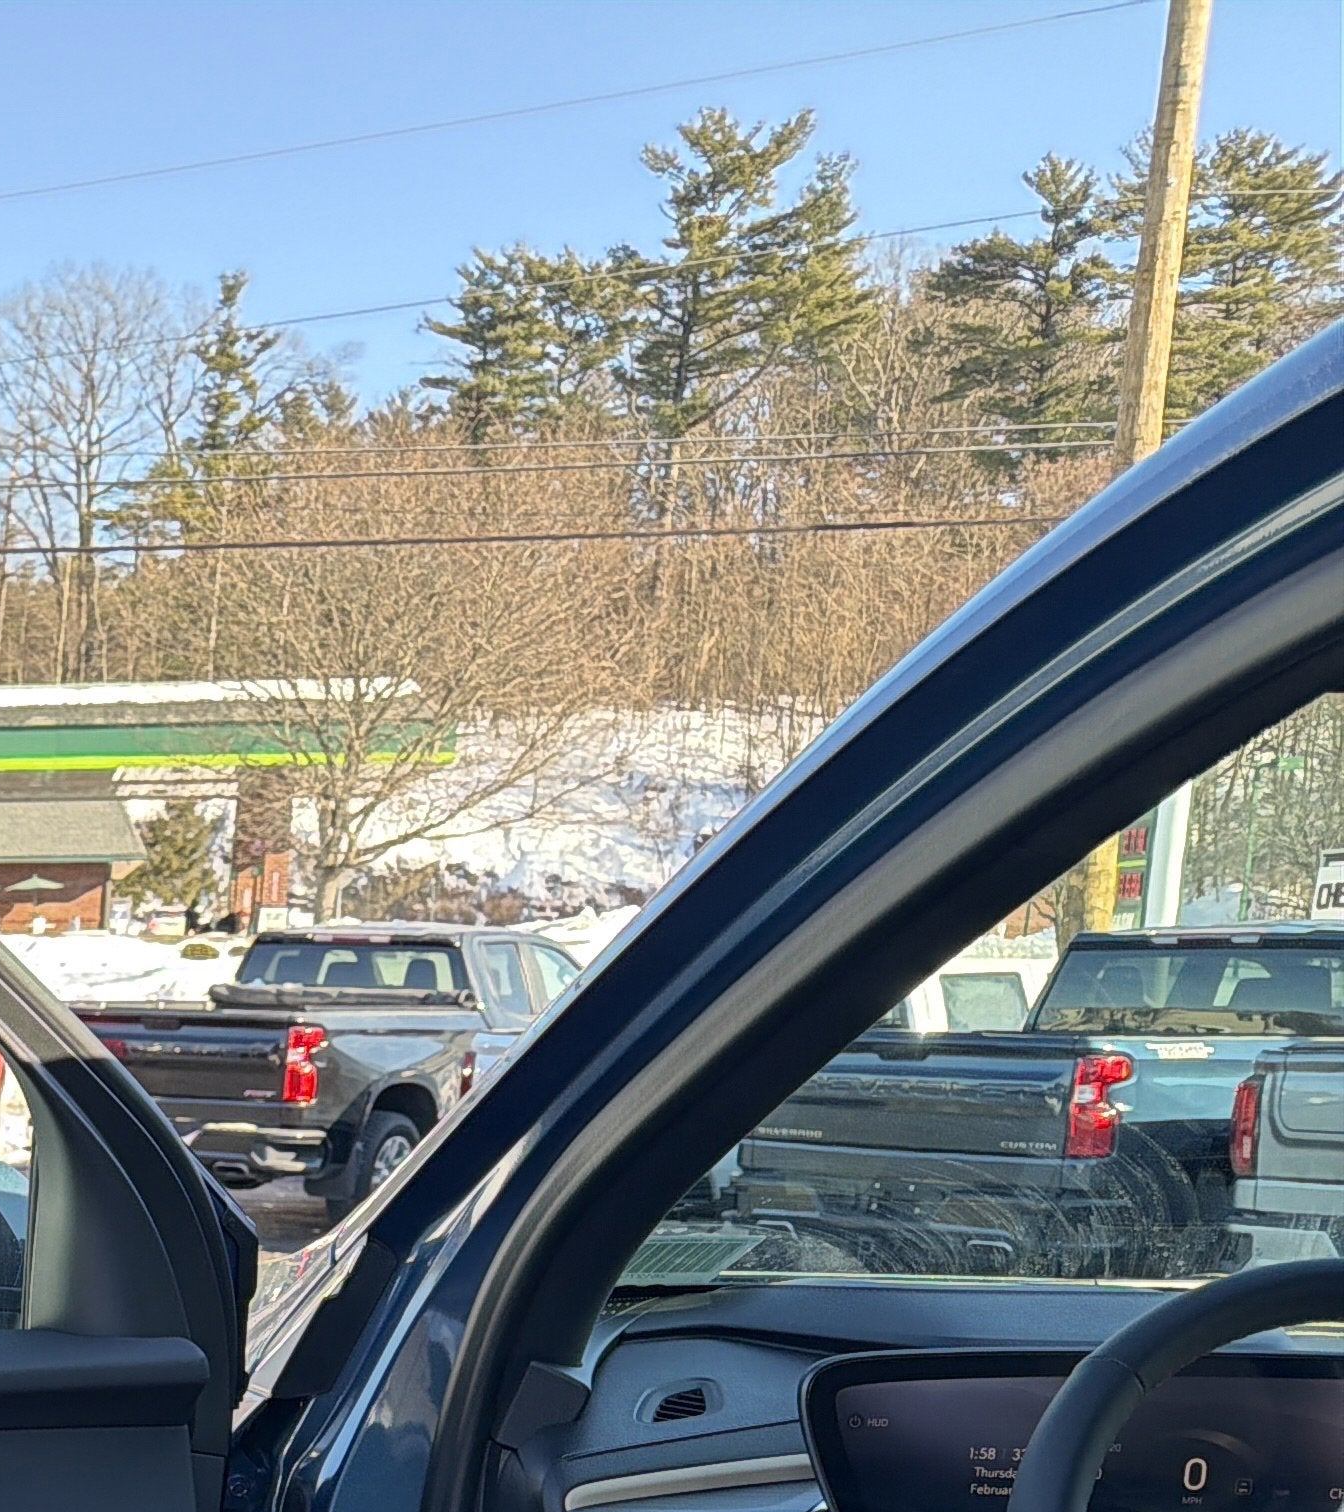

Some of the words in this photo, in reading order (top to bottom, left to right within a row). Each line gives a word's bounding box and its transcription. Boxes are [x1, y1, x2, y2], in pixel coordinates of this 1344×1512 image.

[999, 1141, 1057, 1151] CUSTOM
[866, 1417, 889, 1428] HUD
[969, 1447, 997, 1460] 1:58
[1183, 1457, 1208, 1491] 0
[1181, 1496, 1203, 1504] MPH
